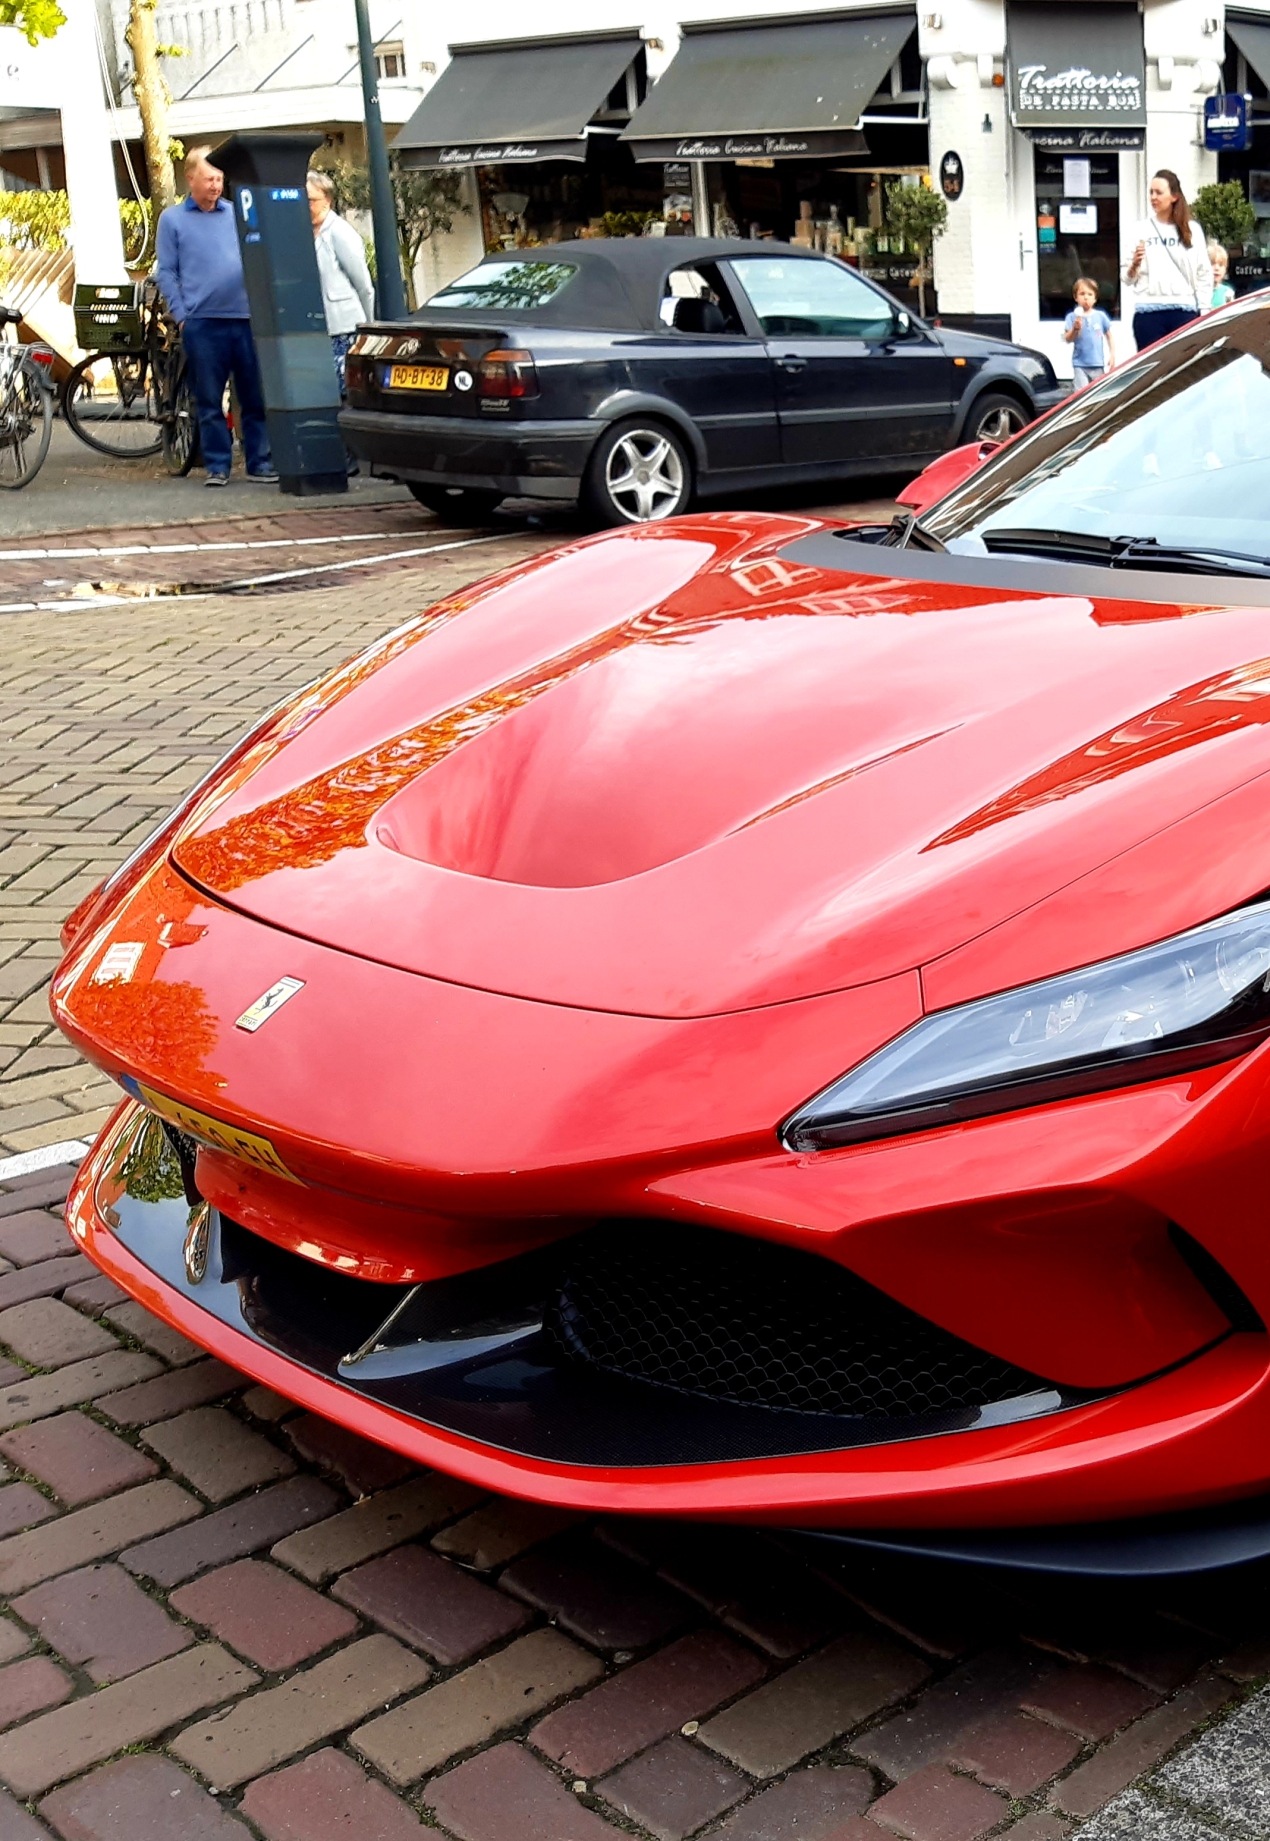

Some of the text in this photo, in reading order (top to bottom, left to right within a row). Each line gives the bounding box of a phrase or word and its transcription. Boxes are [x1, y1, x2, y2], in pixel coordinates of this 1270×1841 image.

[1018, 65, 1140, 89] Trattoria
[1052, 94, 1099, 106] PASTA
[240, 188, 253, 222] P
[1235, 265, 1263, 276] Coffee
